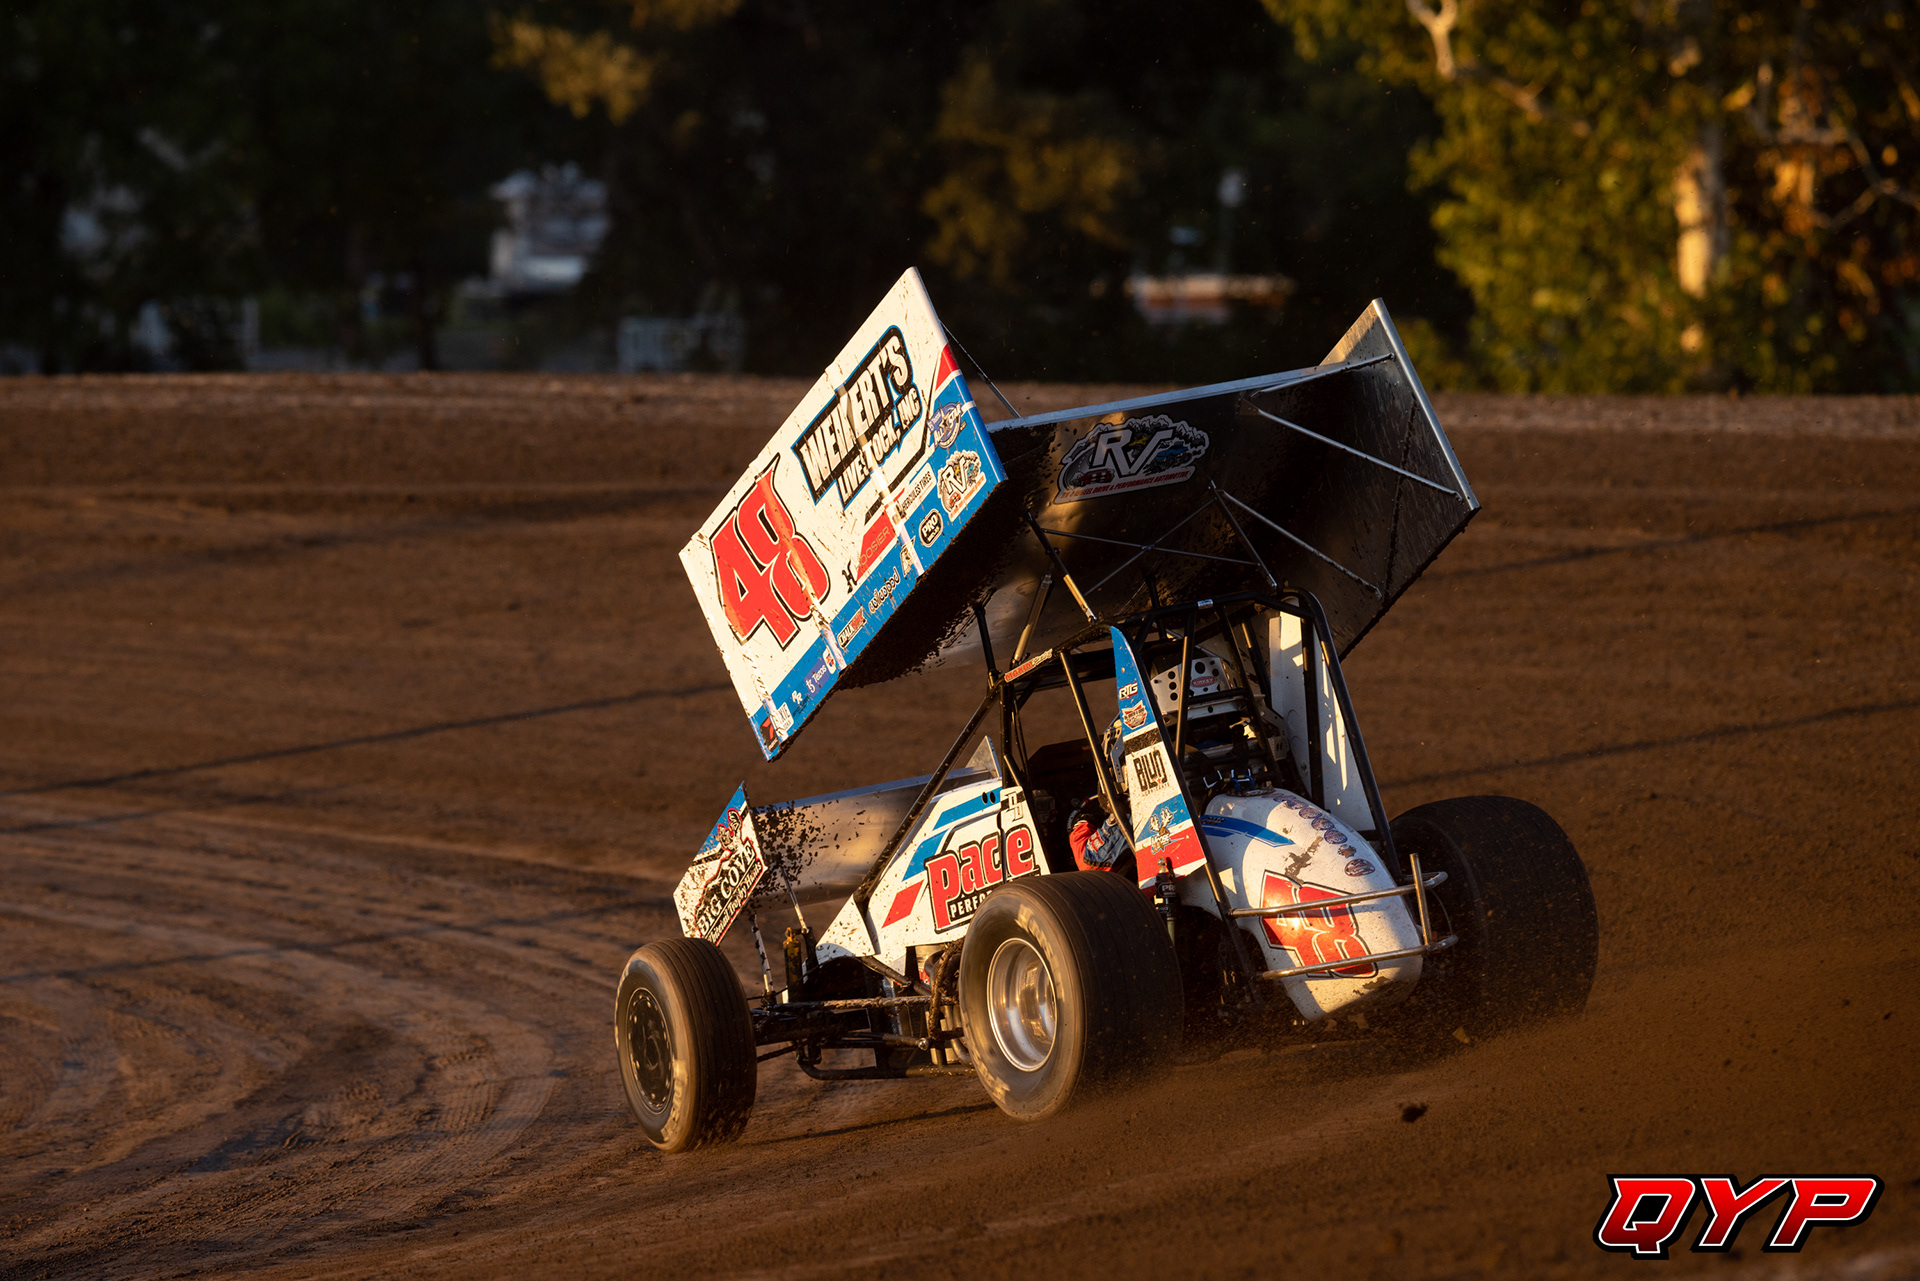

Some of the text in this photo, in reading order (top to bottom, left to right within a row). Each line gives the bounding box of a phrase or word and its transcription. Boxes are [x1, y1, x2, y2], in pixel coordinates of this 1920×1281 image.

[800, 335, 908, 491] WEIKERT'S
[896, 387, 921, 430] INC
[1091, 428, 1174, 477] RV
[941, 456, 968, 495] RV
[856, 526, 891, 570] HOOSIER
[922, 514, 938, 538] PRO
[711, 455, 830, 648] 48
[812, 664, 827, 683] Tezos
[1005, 660, 1035, 681] MAXIM
[1119, 682, 1138, 700] RTG
[697, 842, 756, 937] BIG COVE
[926, 827, 1034, 930] Pace
[1260, 870, 1379, 979] 48
